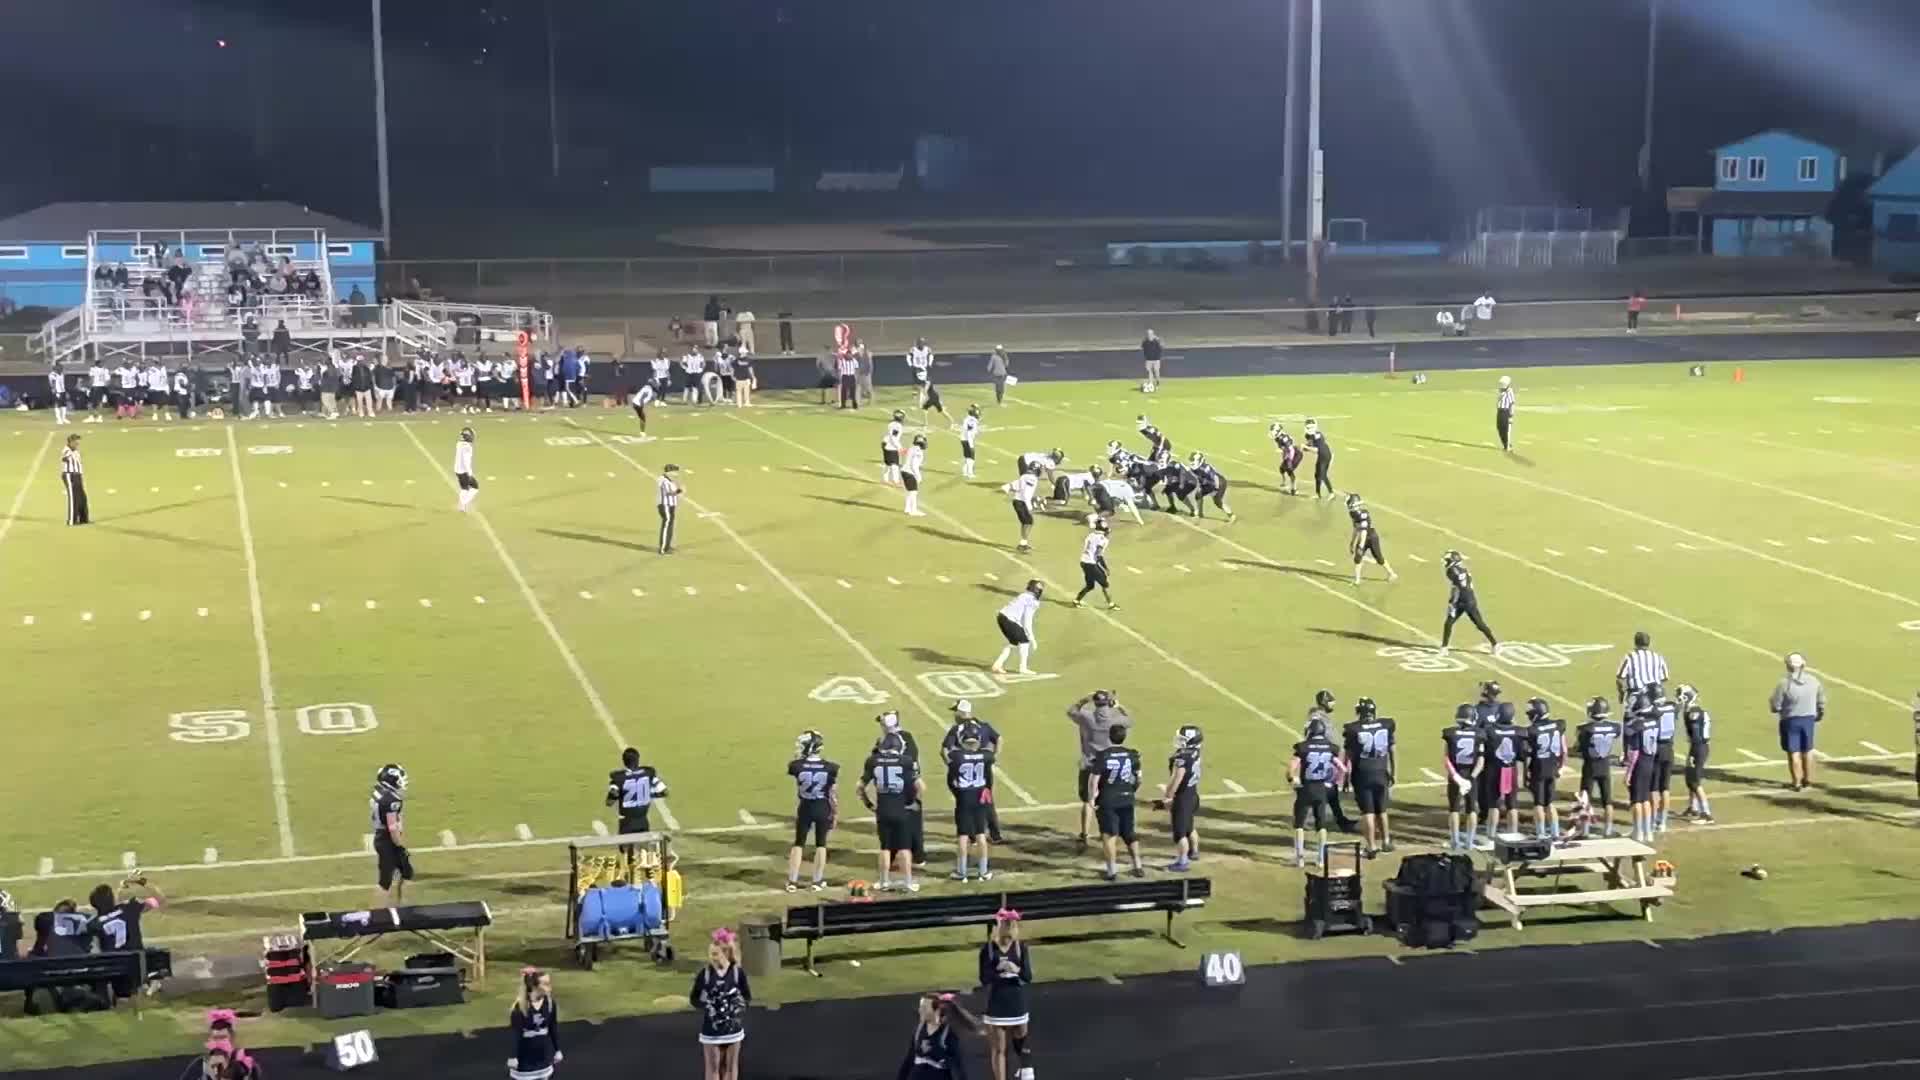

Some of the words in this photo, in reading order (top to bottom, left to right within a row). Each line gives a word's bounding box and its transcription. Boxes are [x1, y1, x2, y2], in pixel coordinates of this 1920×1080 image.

[1456, 737, 1475, 764] 2
[799, 771, 828, 800] 22
[874, 766, 904, 794] 15
[958, 762, 986, 788] 31
[622, 776, 650, 808] 20
[1207, 953, 1241, 983] 40
[337, 1030, 375, 1067] 50
